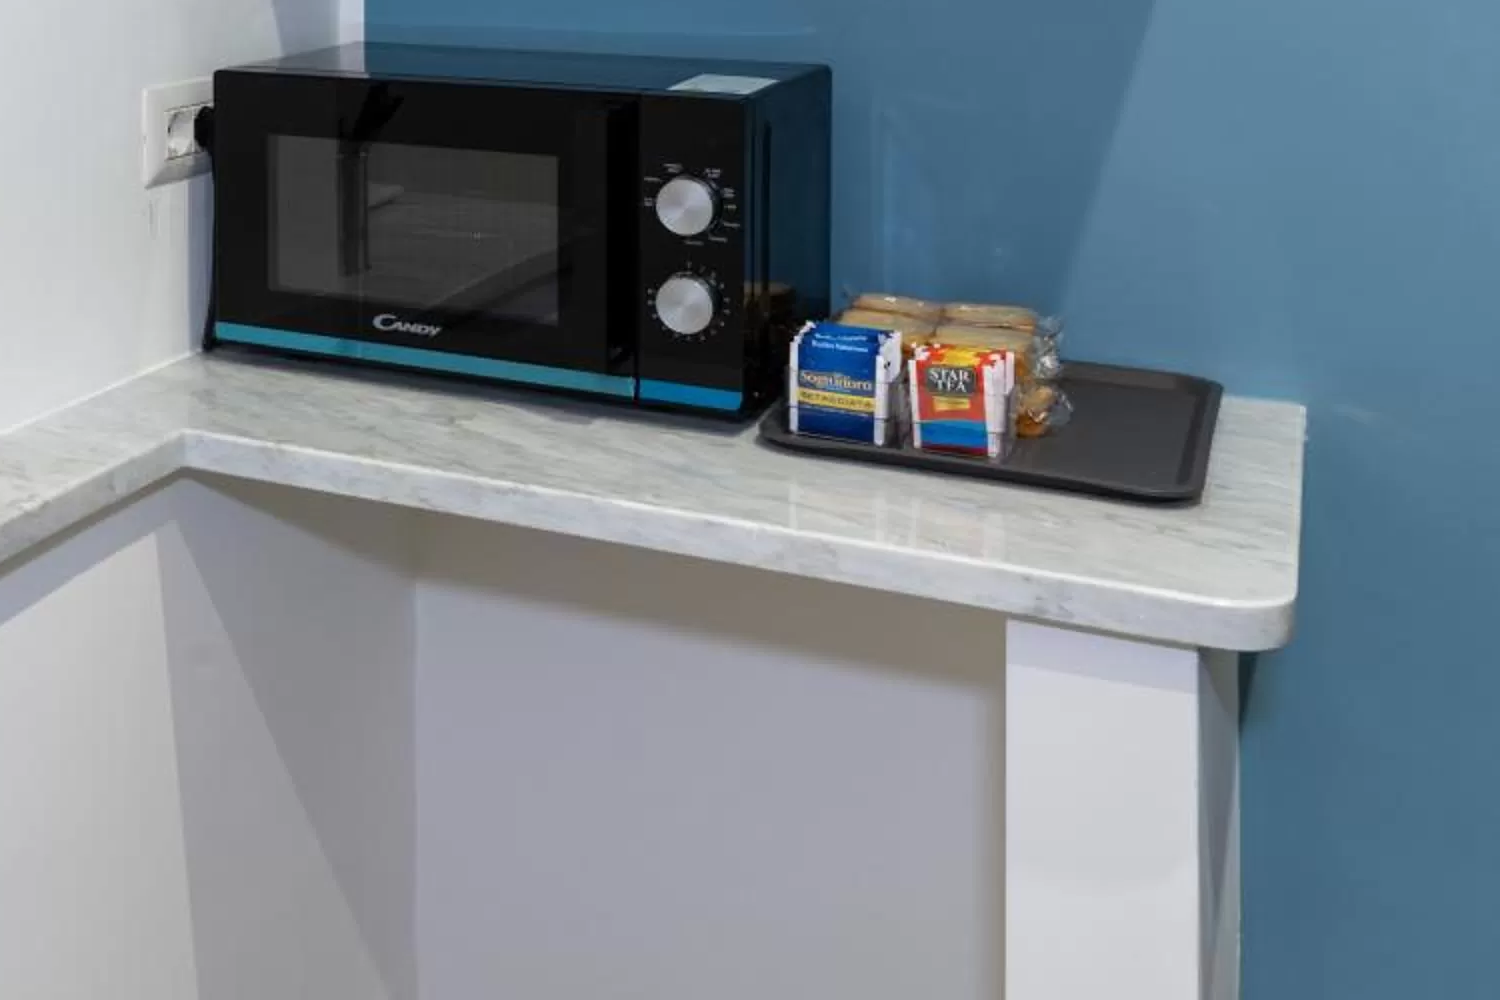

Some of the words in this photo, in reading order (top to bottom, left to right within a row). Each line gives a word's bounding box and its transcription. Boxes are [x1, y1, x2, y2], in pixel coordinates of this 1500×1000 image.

[372, 313, 441, 336] CANDY
[928, 368, 971, 382] STAR
[936, 379, 967, 392] TEA
